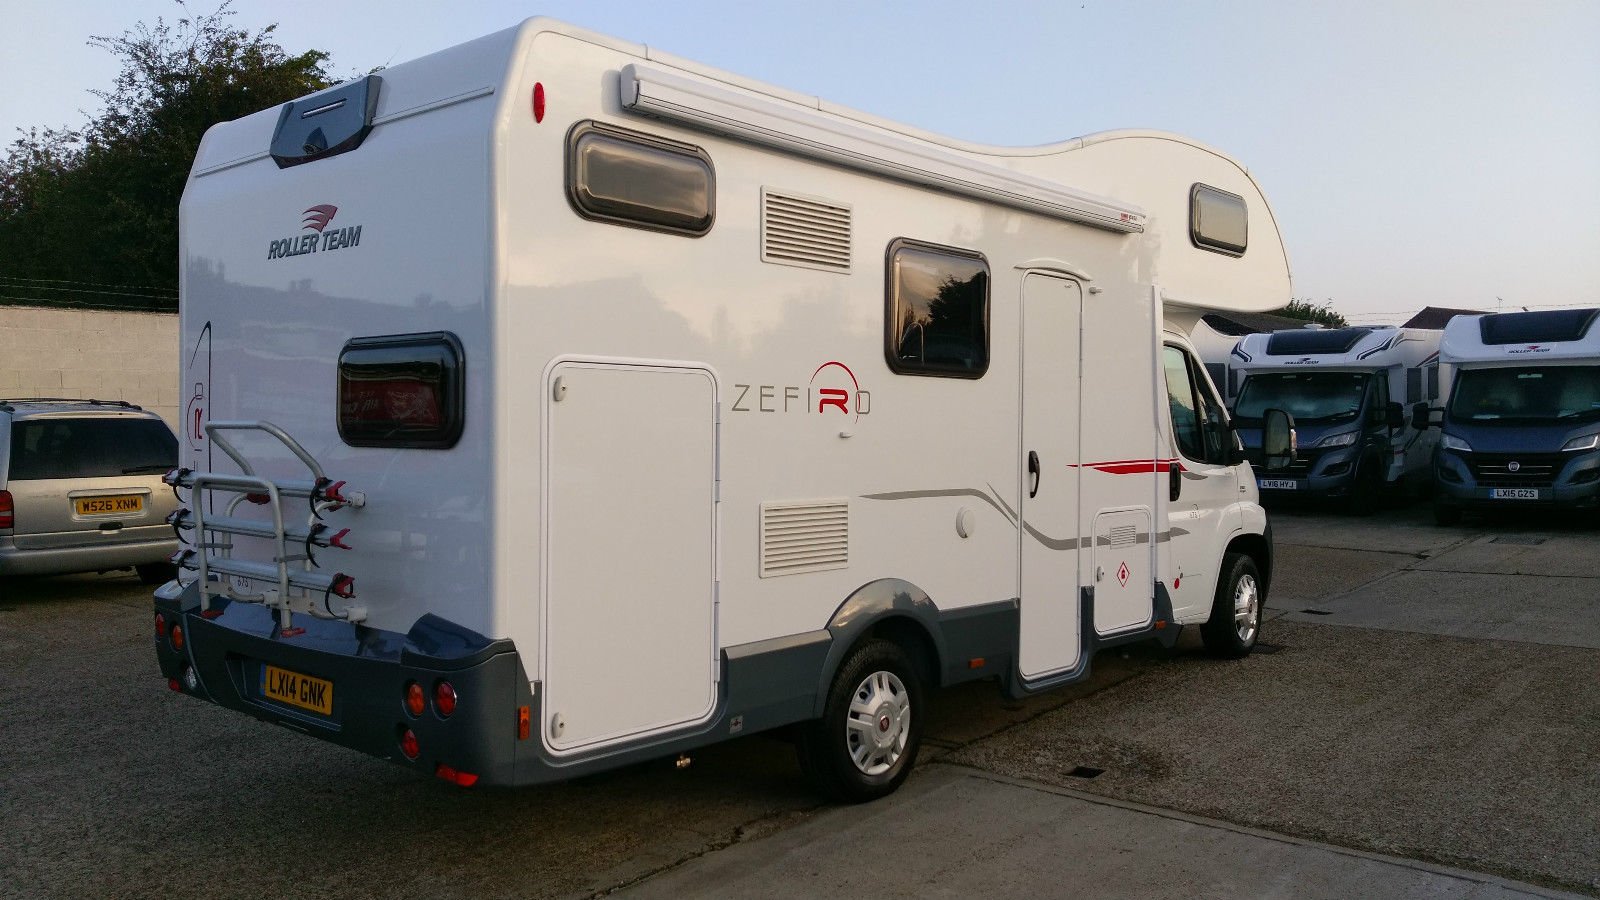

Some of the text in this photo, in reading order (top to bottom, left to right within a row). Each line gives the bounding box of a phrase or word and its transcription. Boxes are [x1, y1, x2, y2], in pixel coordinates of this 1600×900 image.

[267, 225, 362, 260] ROLLER TEAM
[731, 383, 871, 415] ZEFIRO
[1280, 480, 1294, 489] HYJ
[1496, 490, 1516, 498] LX15
[82, 498, 138, 512] W526 XNM
[269, 669, 327, 709] LX14 GNK
